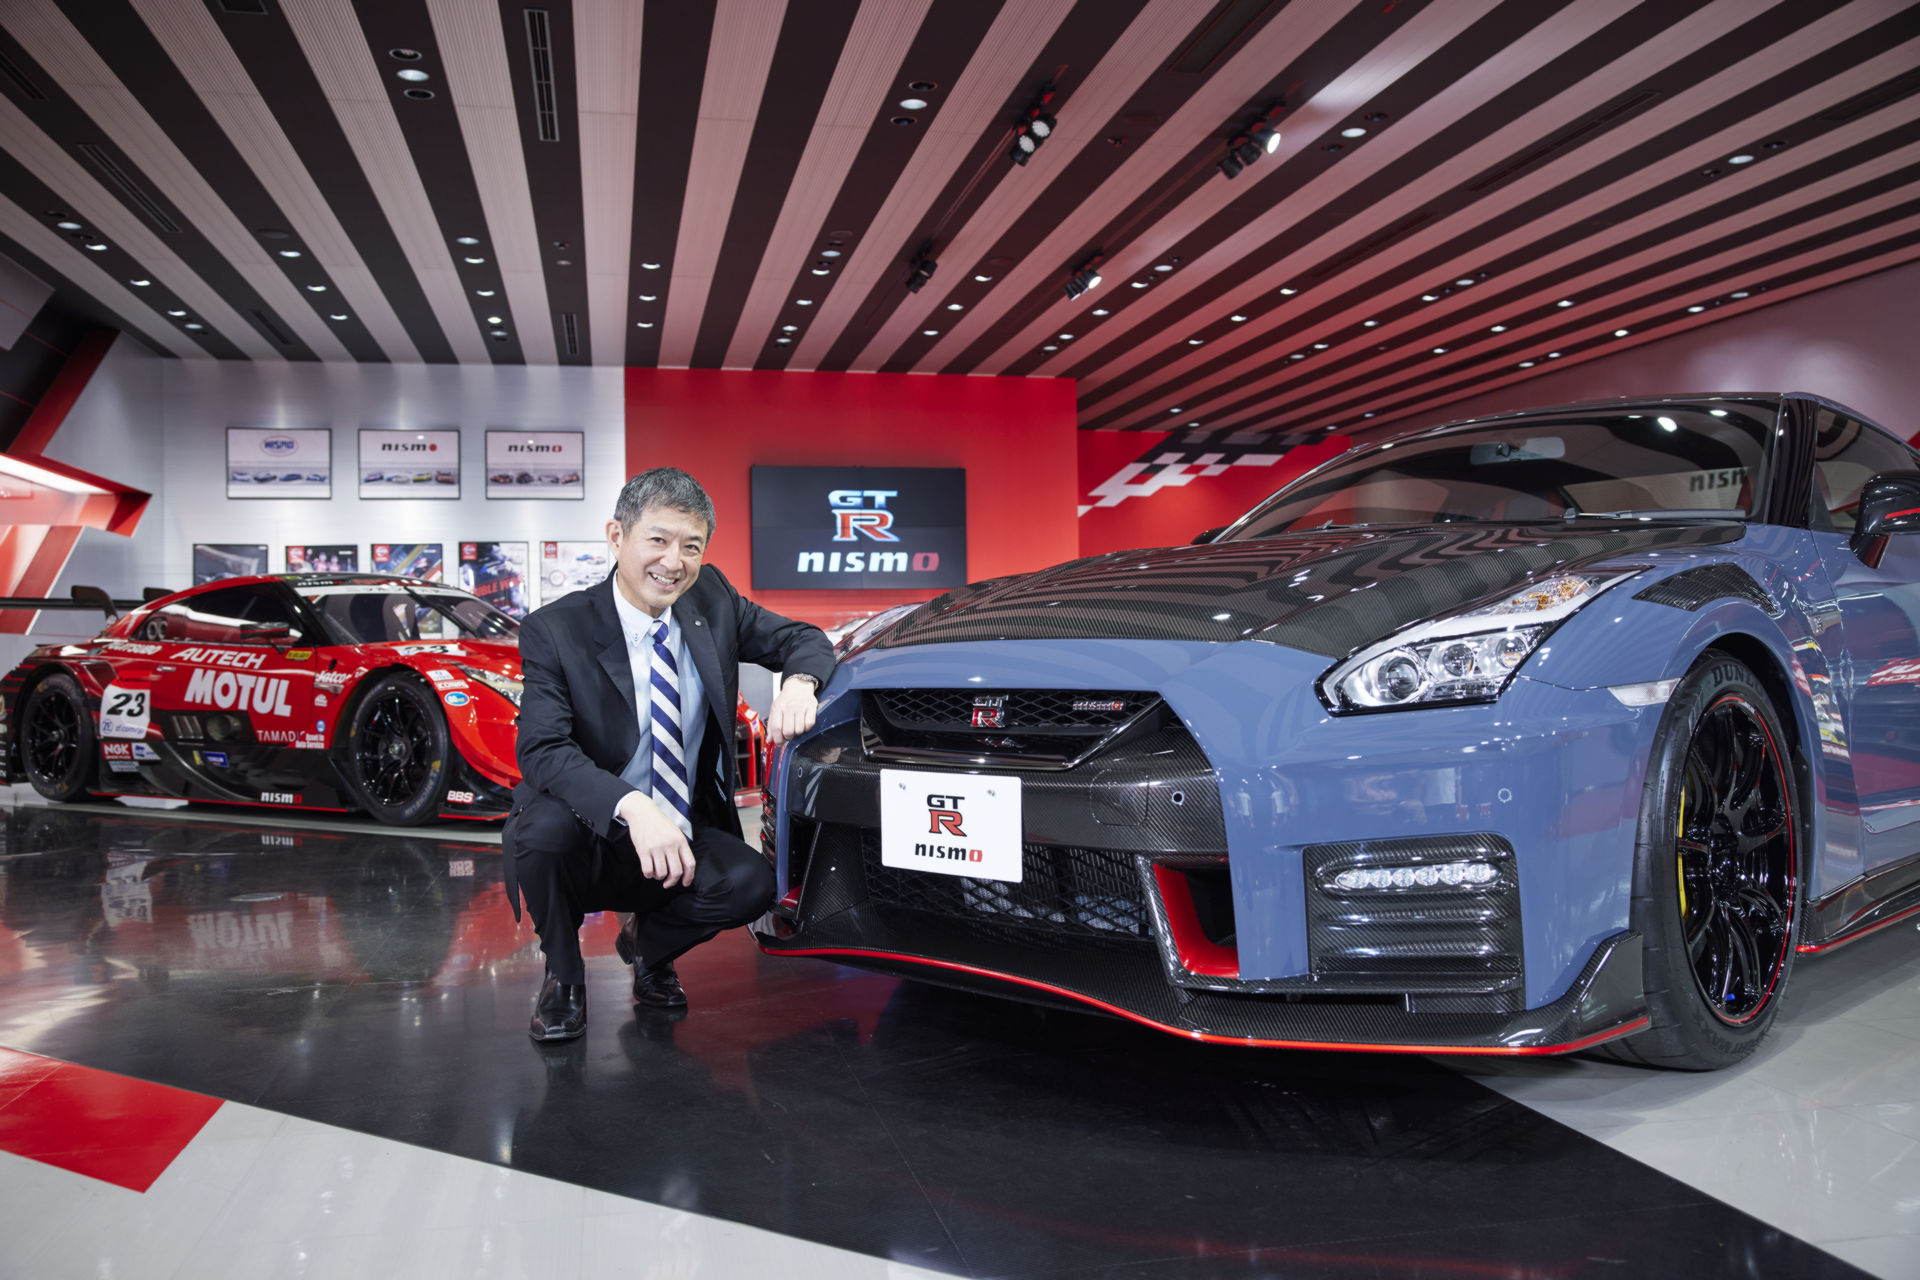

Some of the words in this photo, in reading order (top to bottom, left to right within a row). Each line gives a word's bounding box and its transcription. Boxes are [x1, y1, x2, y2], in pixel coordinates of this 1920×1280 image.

[508, 444, 563, 453] nismo
[1690, 470, 1745, 492] nism
[797, 552, 940, 572] nismo
[169, 647, 267, 669] AUTECH
[184, 668, 292, 717] MOTUL
[106, 692, 146, 717] 23
[103, 744, 130, 755] NGK
[261, 792, 302, 804] nismo
[447, 790, 474, 804] BBS
[926, 794, 966, 811] GT
[928, 809, 967, 837] R
[915, 843, 983, 863] nismo
